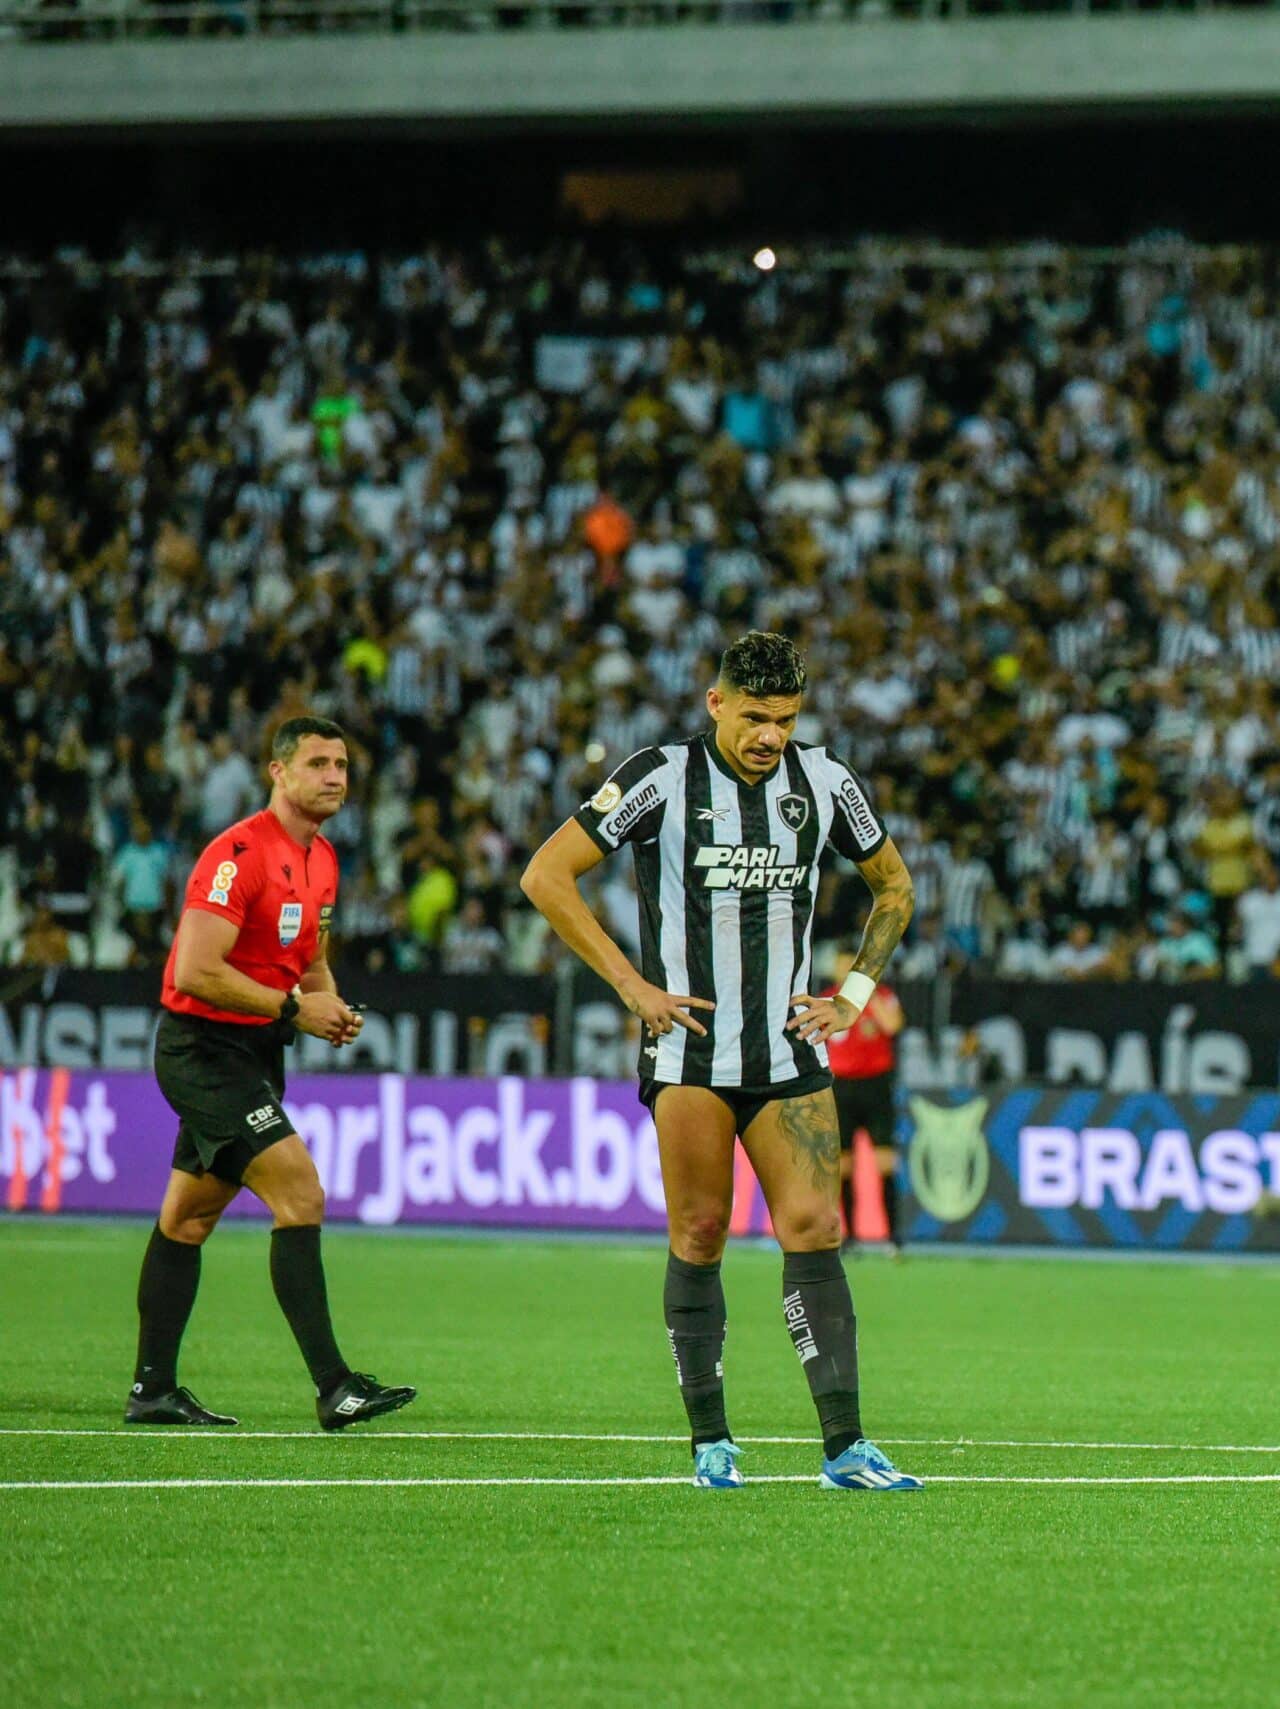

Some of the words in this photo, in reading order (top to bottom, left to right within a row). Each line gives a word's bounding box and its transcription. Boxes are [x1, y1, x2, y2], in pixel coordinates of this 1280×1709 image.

[606, 783, 658, 837] Centrum
[841, 778, 878, 840] Centrum
[717, 847, 778, 867] PARI
[726, 866, 807, 889] MATCH
[283, 907, 300, 918] FIFA
[246, 1105, 275, 1126] CBF
